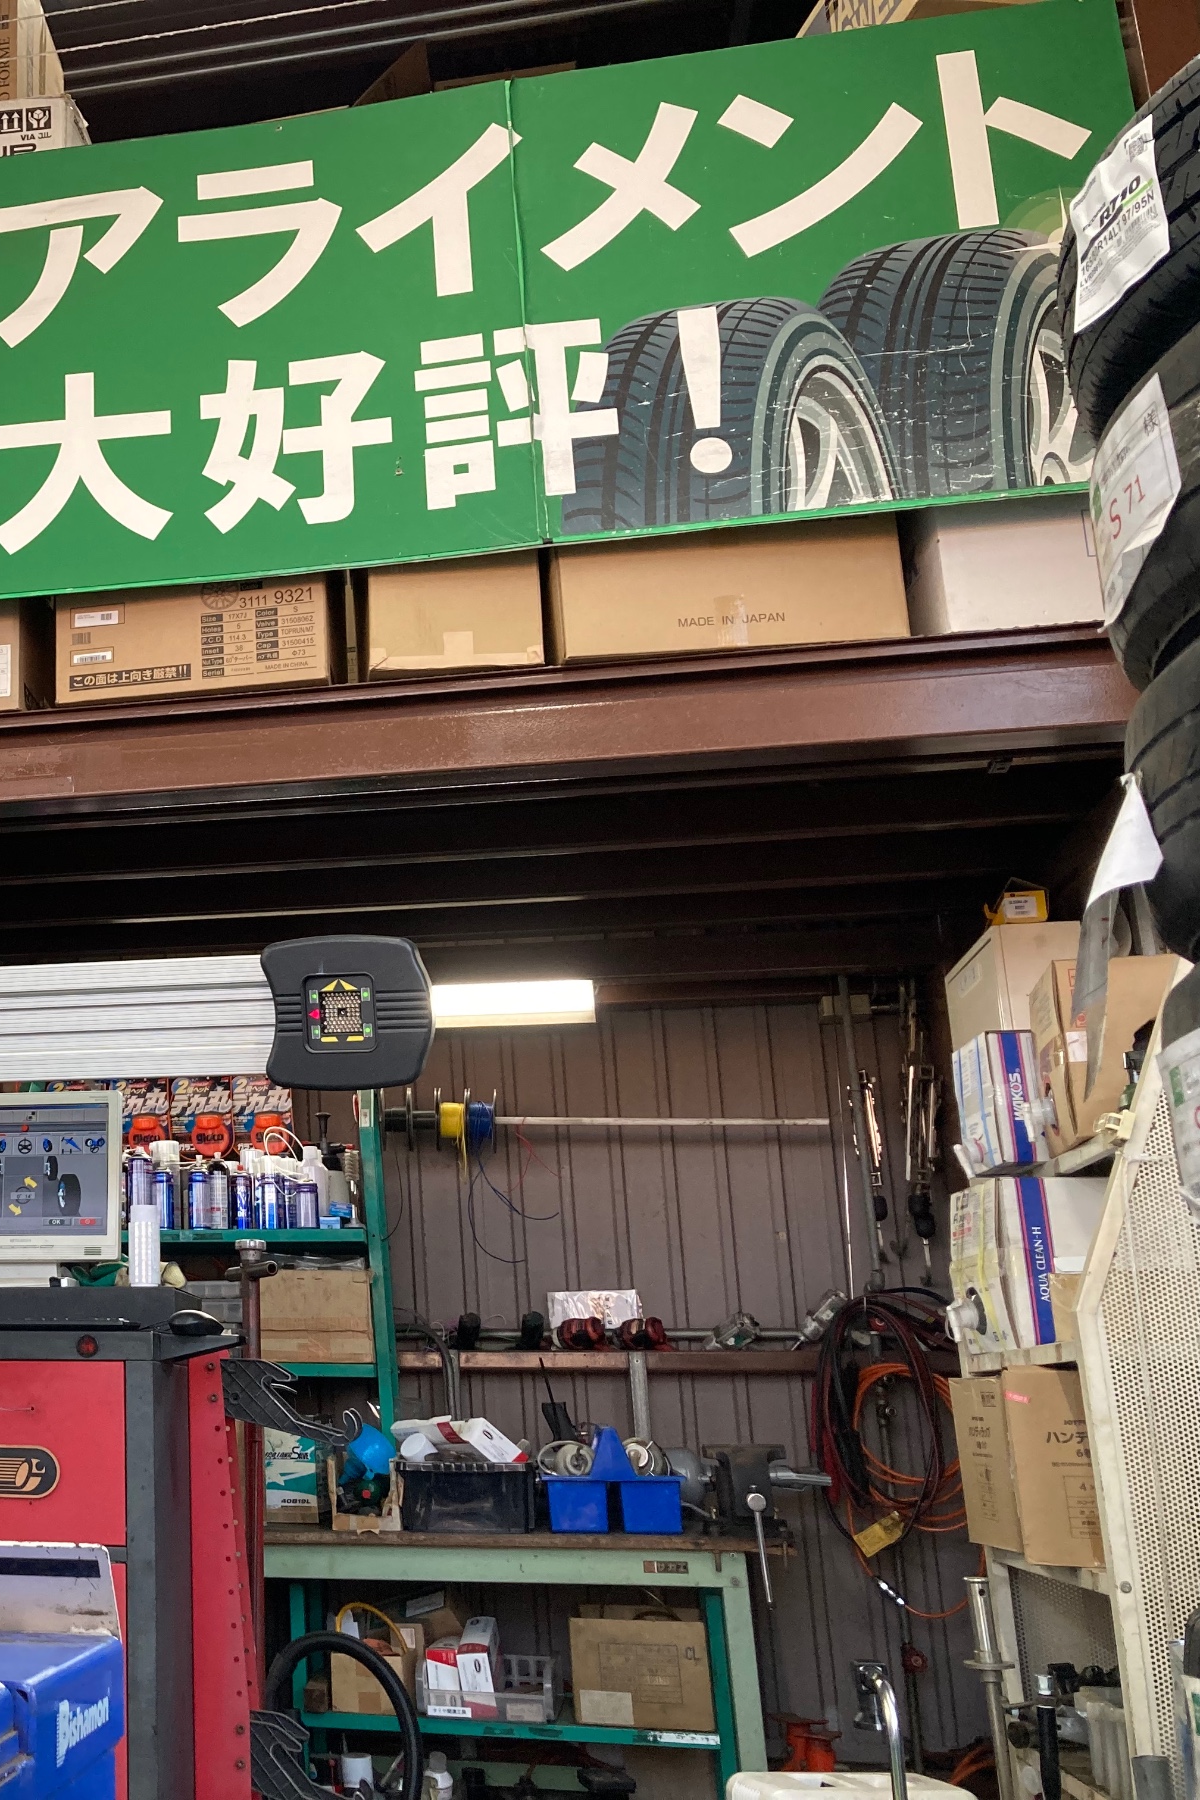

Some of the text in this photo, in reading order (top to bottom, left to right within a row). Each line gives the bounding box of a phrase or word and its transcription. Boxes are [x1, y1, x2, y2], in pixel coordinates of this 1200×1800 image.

[20, 133, 36, 141] VIA
[1122, 189, 1155, 227] 97/95N
[239, 587, 313, 608] 3111 9321
[677, 611, 787, 628] MADE IN JAPAN
[72, 664, 188, 687] この面は上向き厳禁!!
[170, 1085, 233, 1117] デカ丸
[232, 1085, 293, 1116] デカ丸
[1031, 1226, 1051, 1302] AQUA CLEAN-H
[56, 1695, 110, 1768] Bishamon
